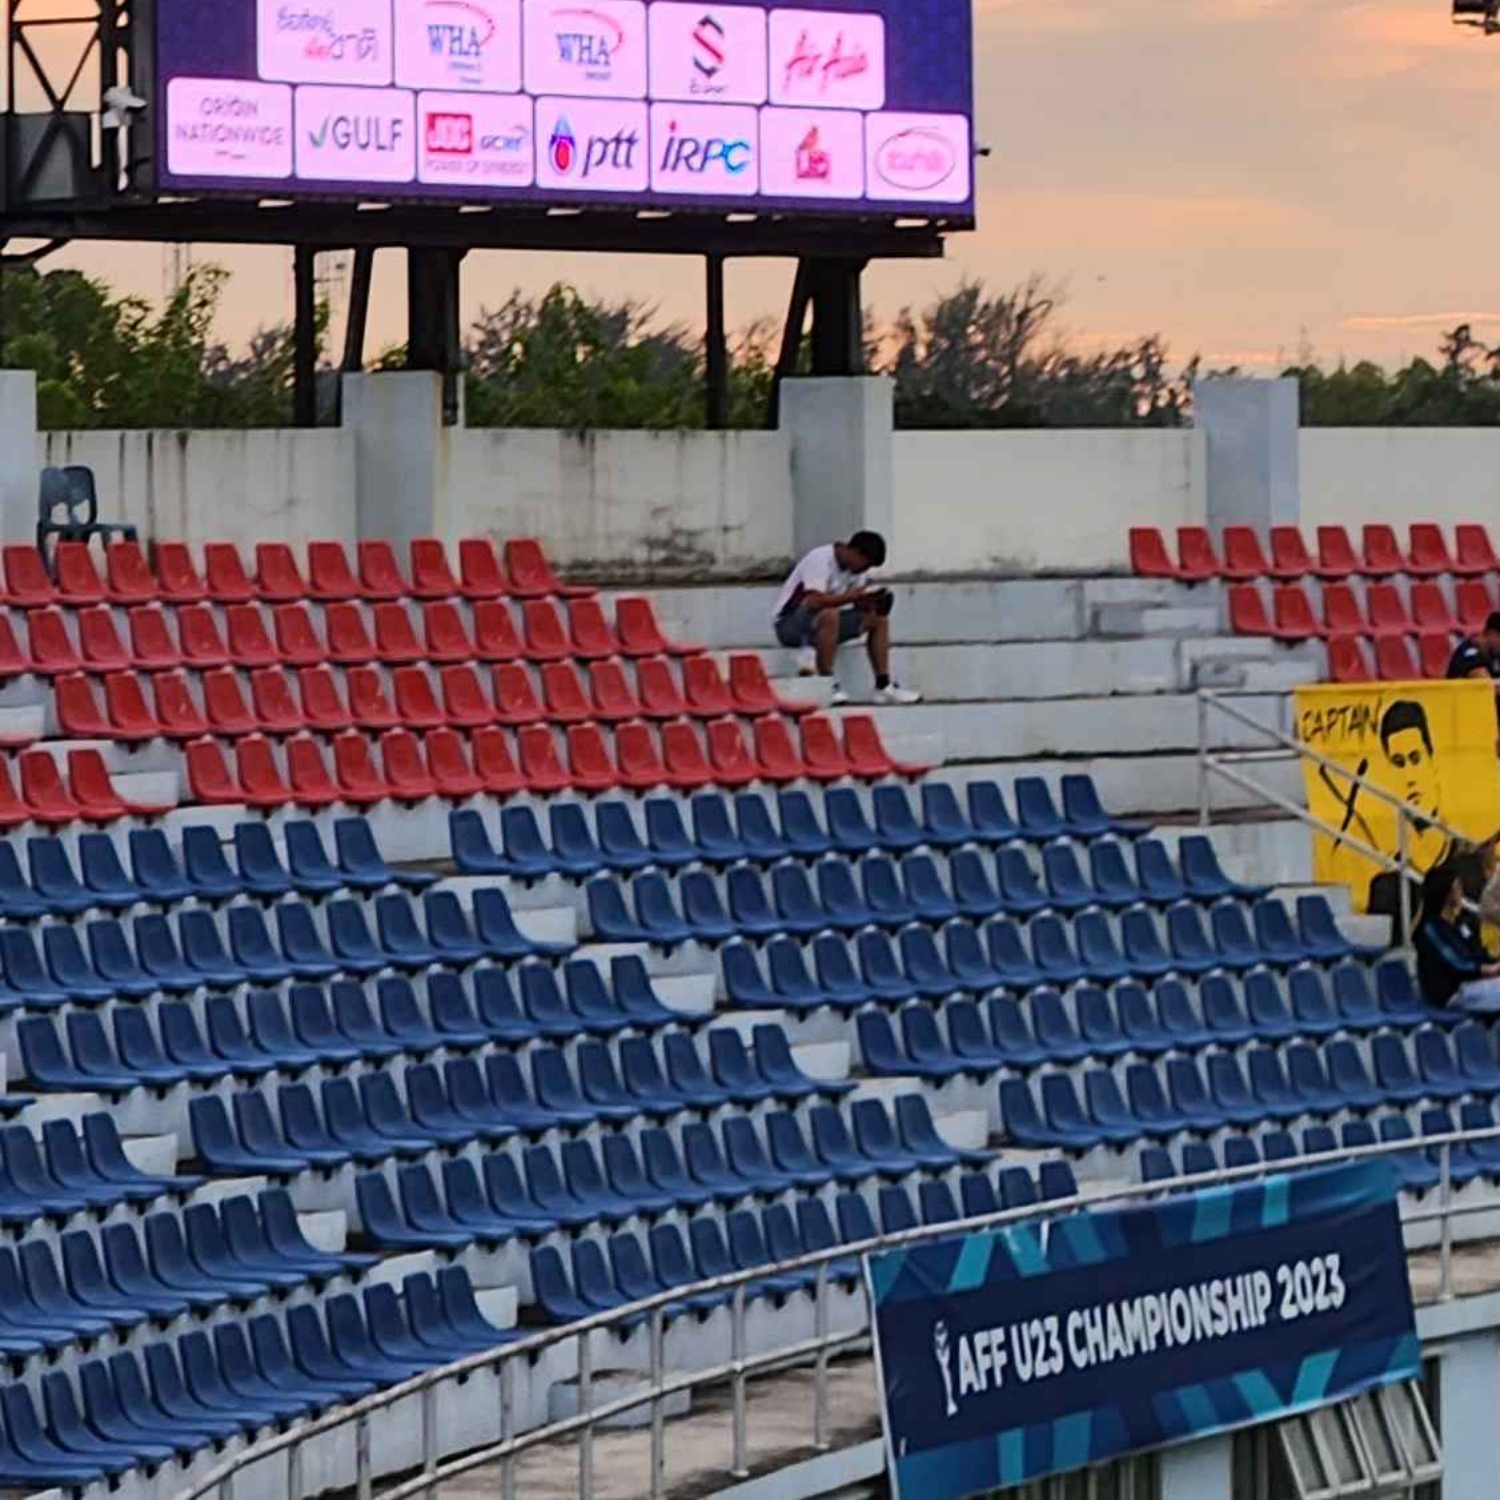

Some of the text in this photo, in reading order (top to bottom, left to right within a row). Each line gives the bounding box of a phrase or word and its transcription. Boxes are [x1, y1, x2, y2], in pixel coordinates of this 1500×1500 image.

[426, 23, 483, 57] WHA
[555, 33, 611, 67] WHA
[331, 115, 403, 151] GULF
[582, 128, 639, 178] ptt
[1302, 694, 1382, 743] CAPTAIN
[958, 1253, 1346, 1395] AFF U23 CHAMPIONSHIP 2023
